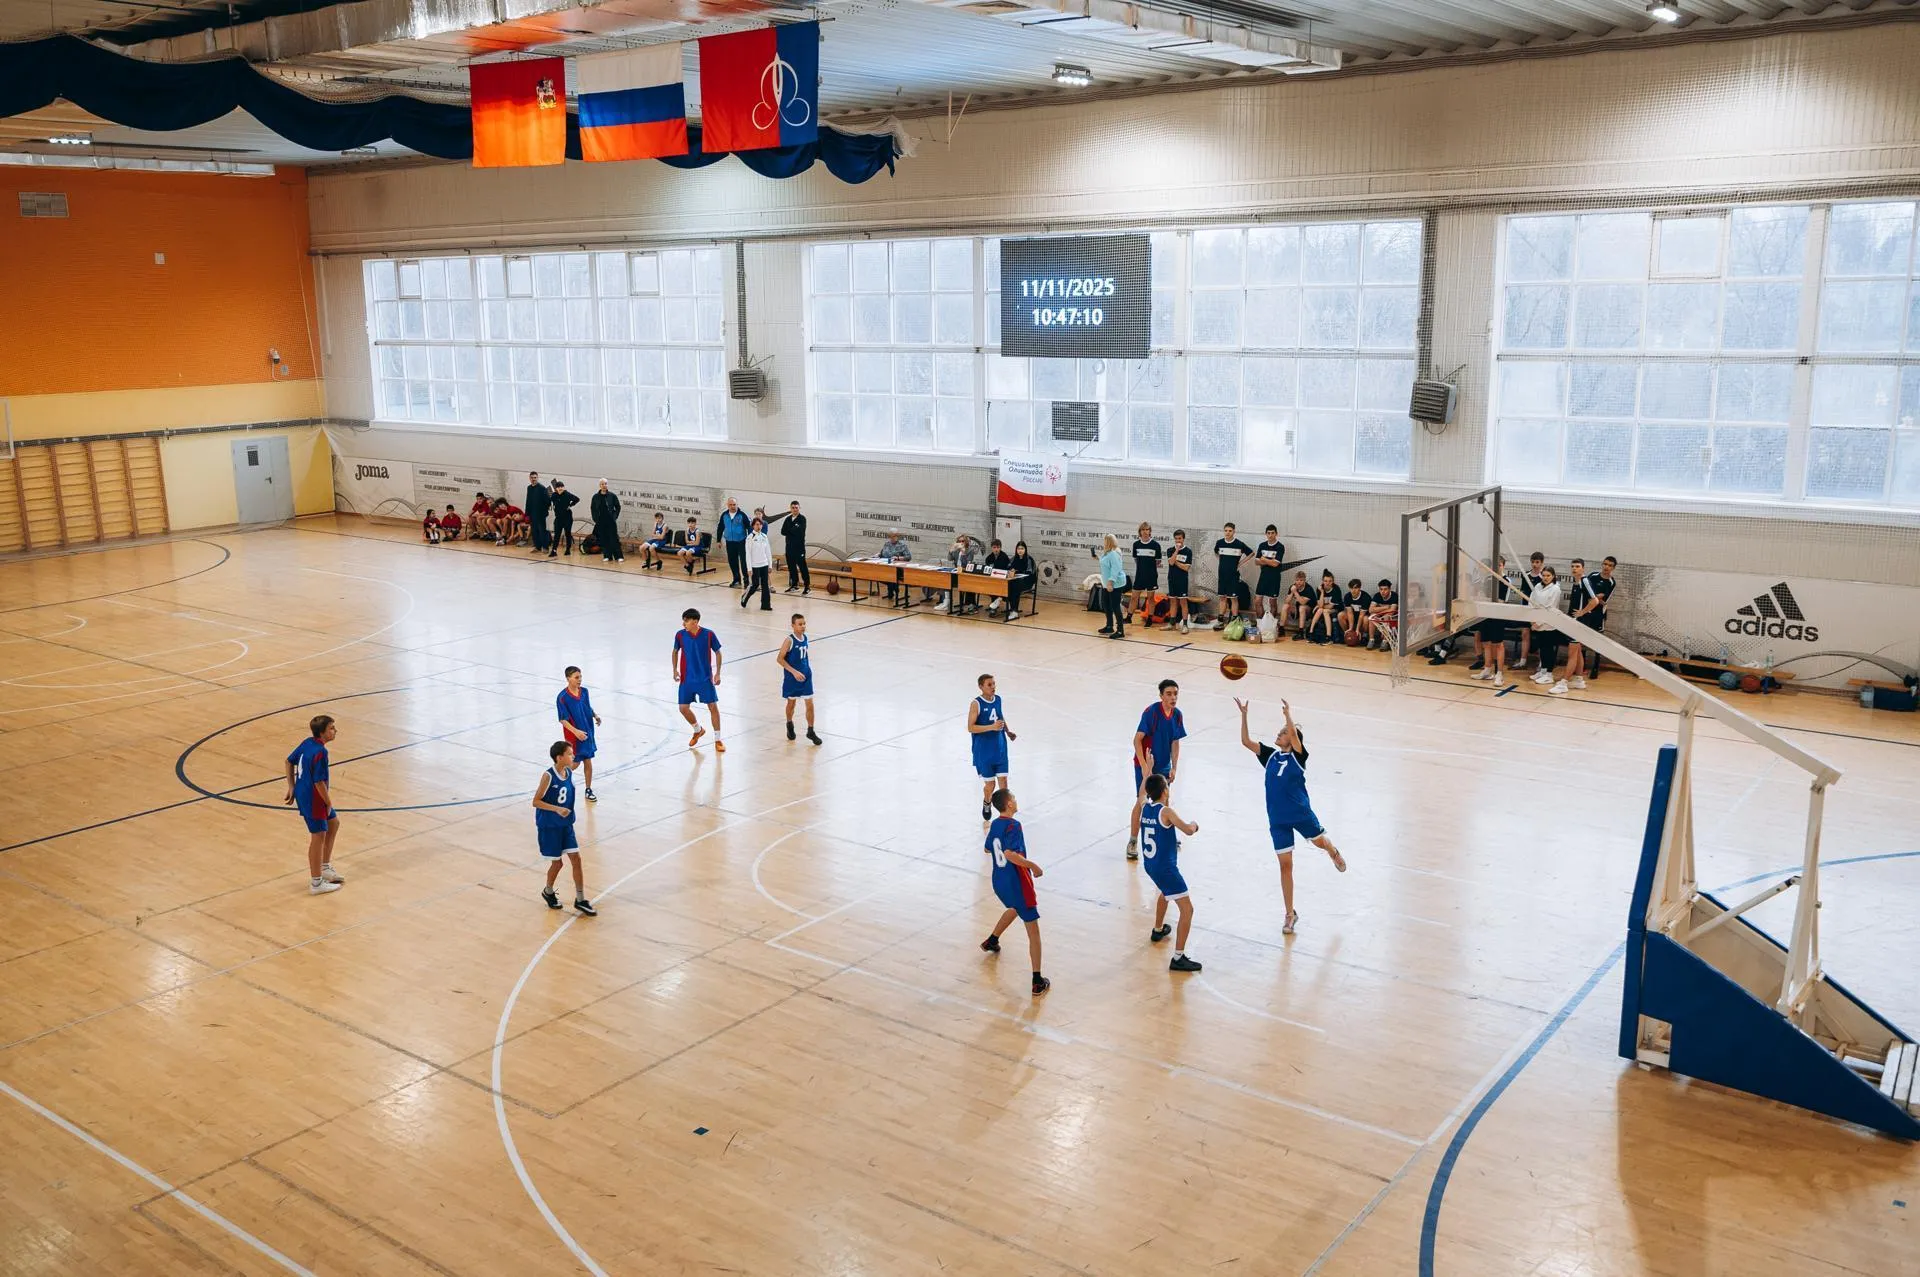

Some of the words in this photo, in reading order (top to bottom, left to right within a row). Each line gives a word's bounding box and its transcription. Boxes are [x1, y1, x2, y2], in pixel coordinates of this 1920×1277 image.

[1020, 277, 1115, 298] 11/11/2025
[1032, 308, 1103, 325] 10:47:10
[1003, 458, 1043, 469] Специальная
[1008, 466, 1043, 476] Олимпиада
[1724, 615, 1819, 642] adidas
[988, 707, 998, 722] 4
[1277, 759, 1288, 777] 7
[557, 786, 567, 804] 8
[1143, 826, 1157, 859] 5
